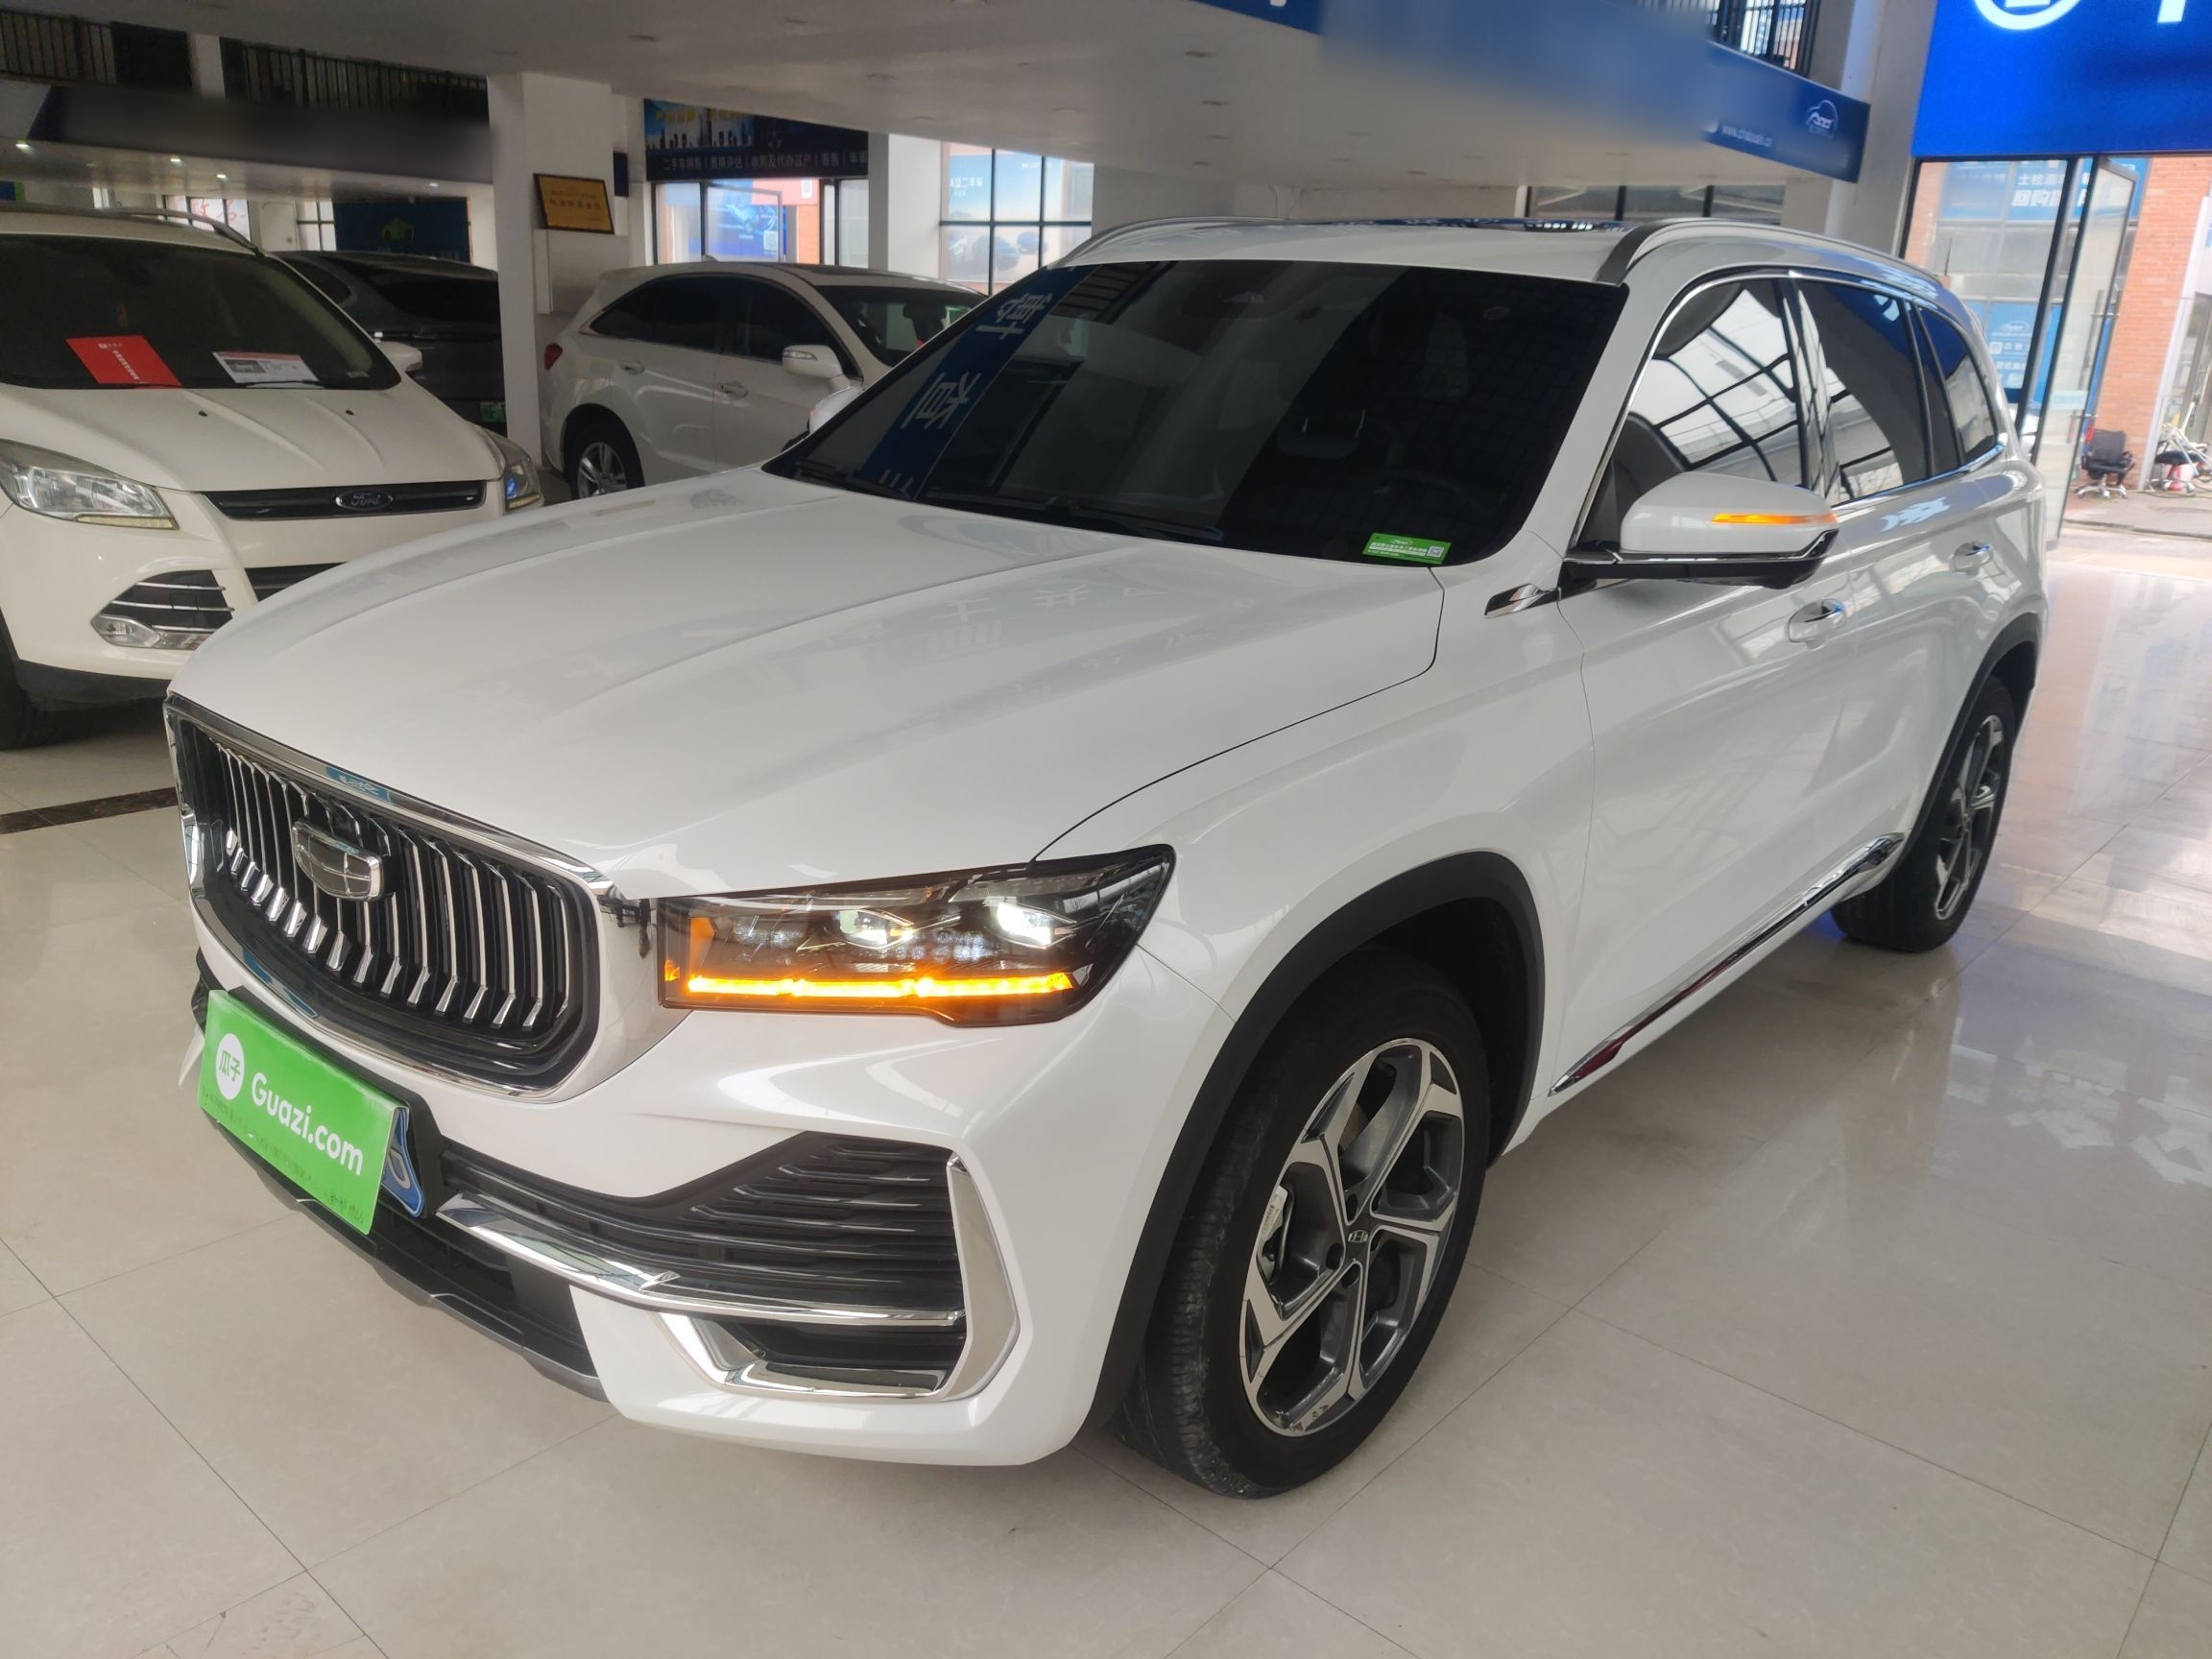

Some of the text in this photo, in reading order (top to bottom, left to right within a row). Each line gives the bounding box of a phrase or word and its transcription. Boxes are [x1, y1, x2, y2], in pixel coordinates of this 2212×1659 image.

[351, 492, 381, 507] Ford
[218, 1049, 241, 1083] 瓜子
[251, 1071, 364, 1177] Guazi.com
